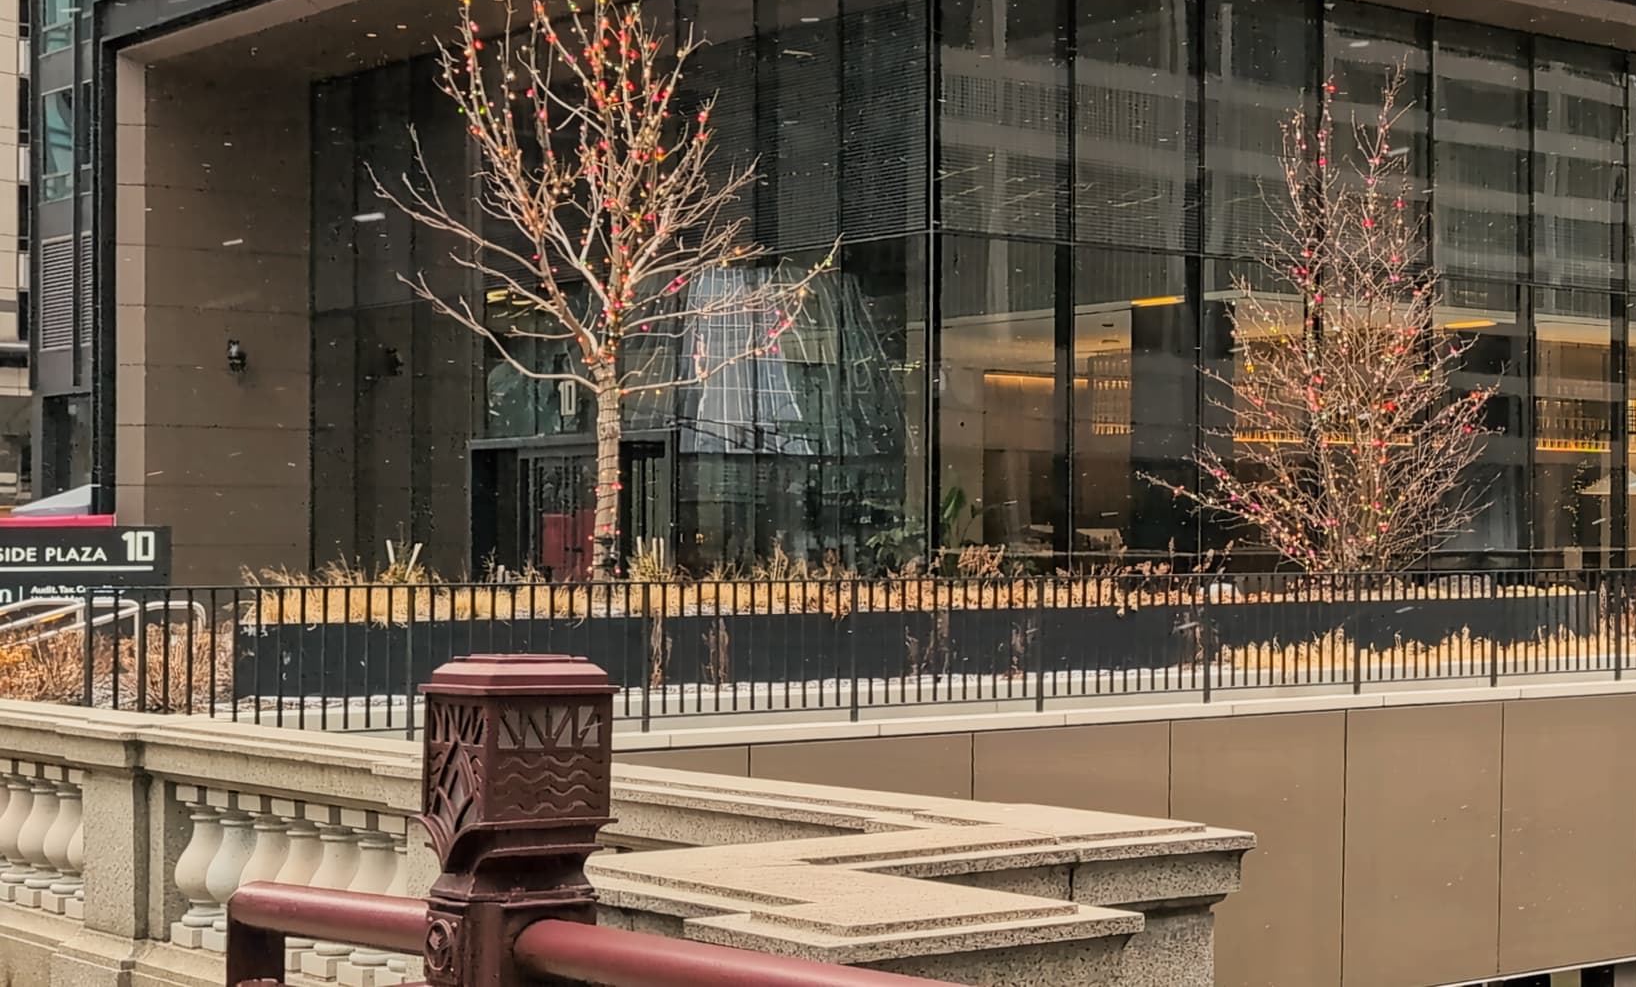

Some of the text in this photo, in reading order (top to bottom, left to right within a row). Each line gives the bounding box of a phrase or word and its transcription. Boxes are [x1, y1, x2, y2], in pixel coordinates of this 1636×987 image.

[558, 380, 576, 416] 10
[45, 547, 107, 562] PLAZA
[121, 531, 155, 561] 10
